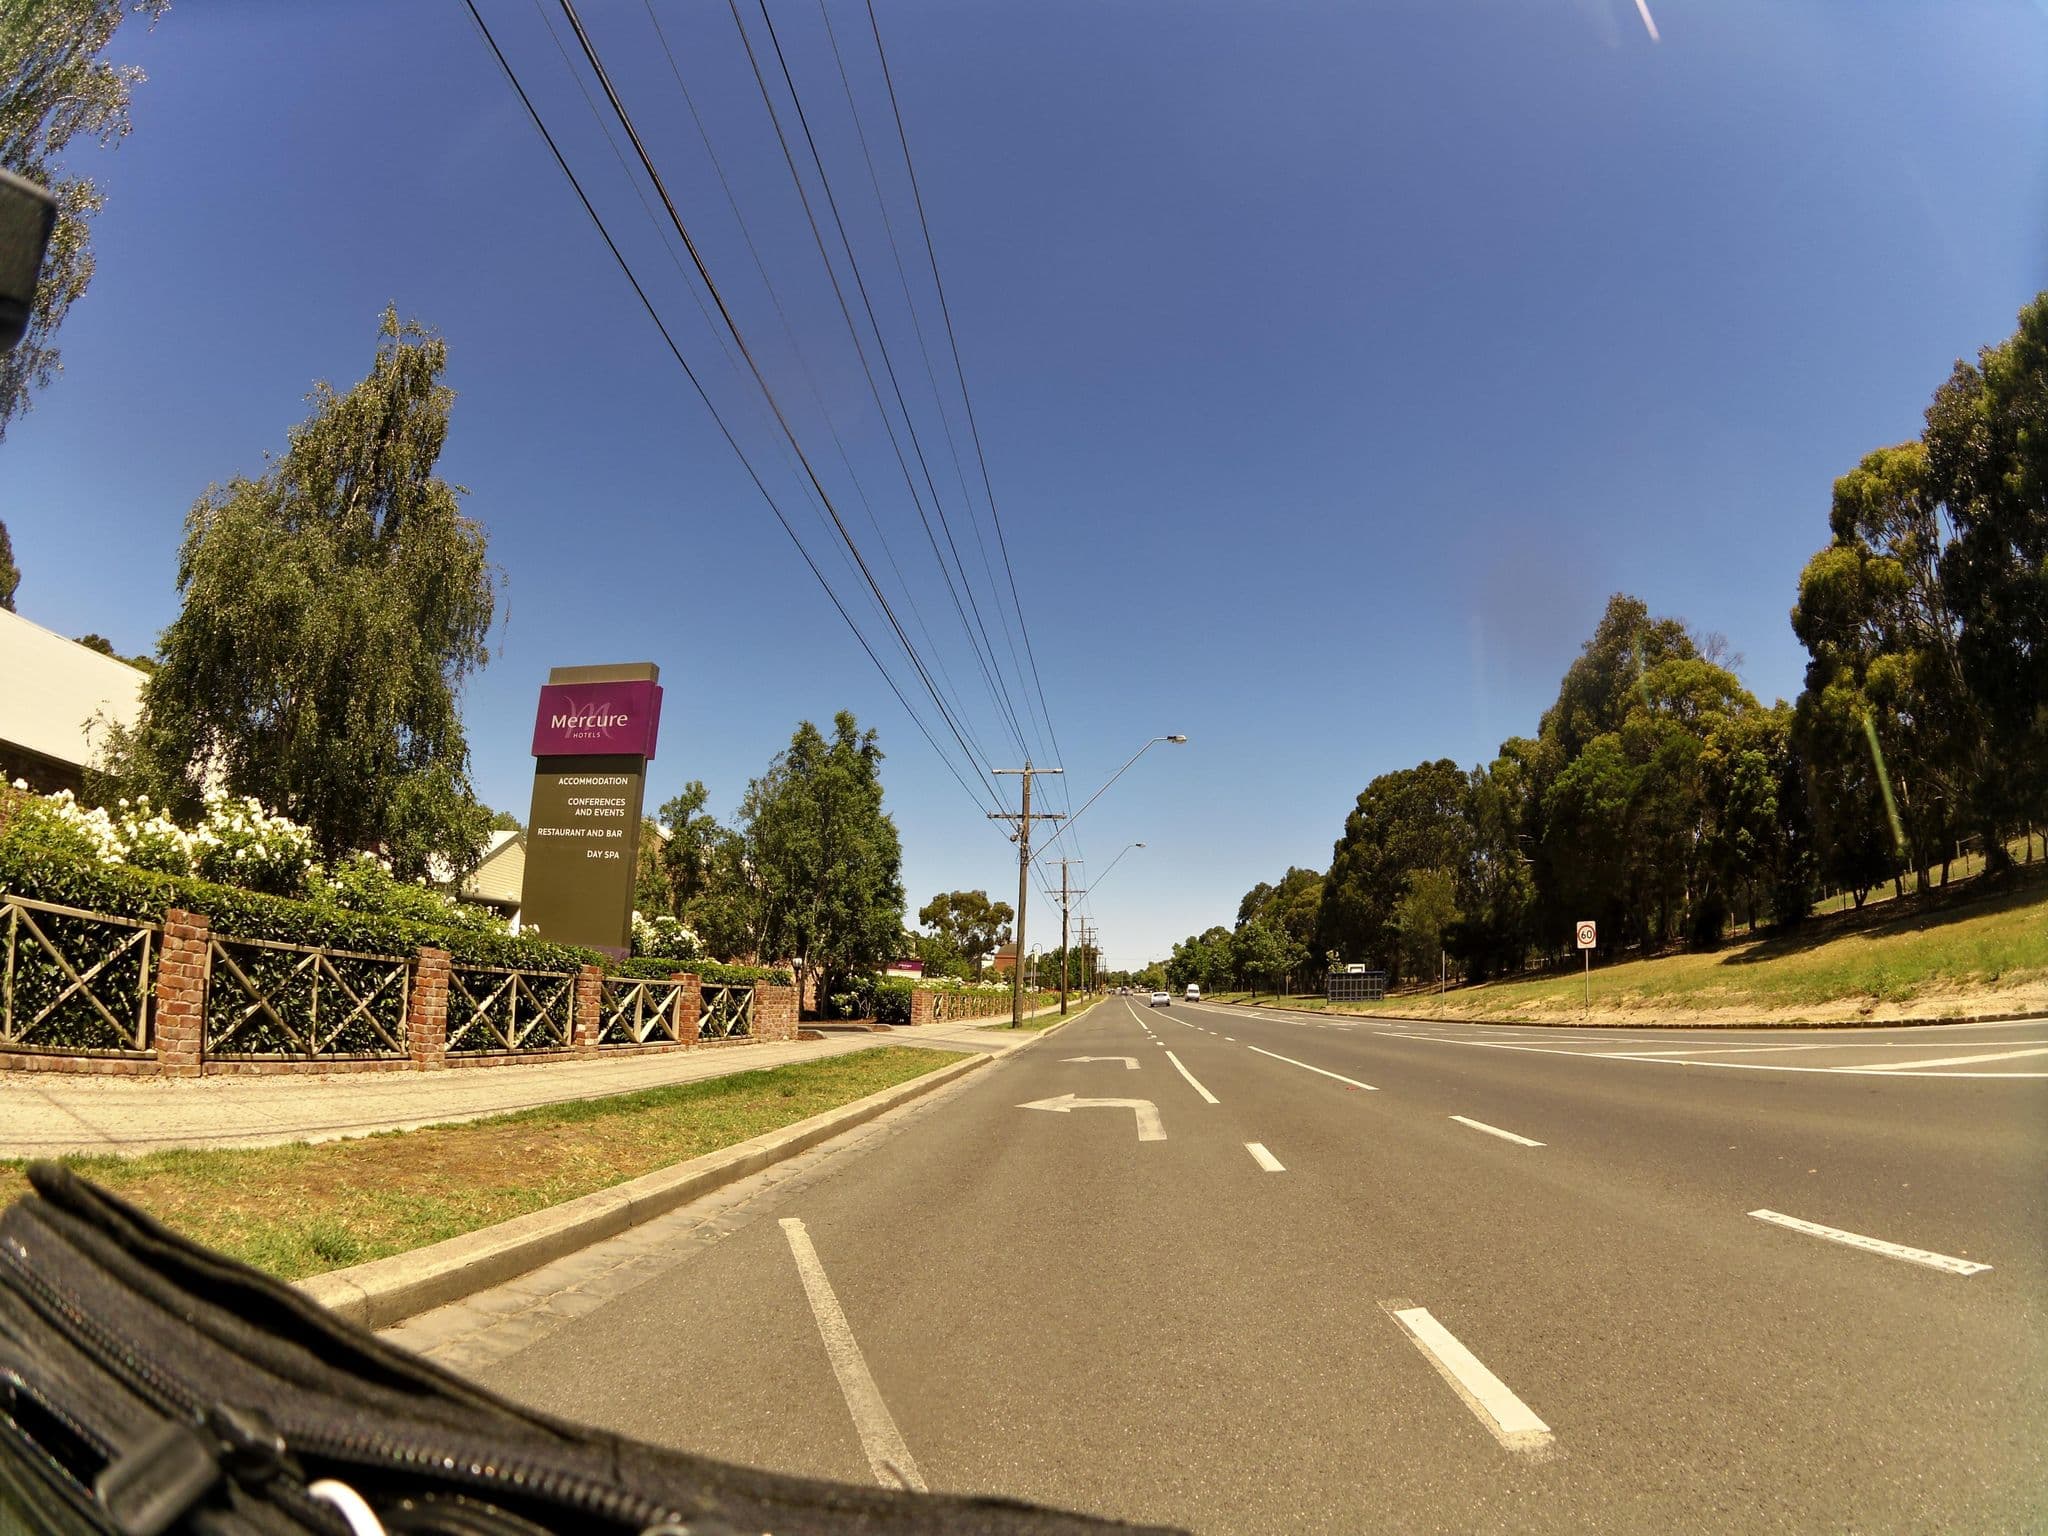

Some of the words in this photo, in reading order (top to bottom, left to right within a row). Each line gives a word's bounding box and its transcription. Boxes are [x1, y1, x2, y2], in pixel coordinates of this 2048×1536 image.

[551, 713, 629, 729] Mercure
[573, 731, 601, 739] HOTELS
[558, 777, 629, 785] ACCOMMODATION
[567, 797, 626, 806] CONFERENCES
[574, 808, 593, 816] AND
[594, 808, 625, 817] EVENTS
[537, 827, 586, 837] RESTAURANT
[586, 828, 605, 838] AND
[606, 829, 623, 838] BAR
[586, 850, 604, 858] DAY
[603, 851, 620, 860] SPA
[1581, 930, 1593, 940] 60
